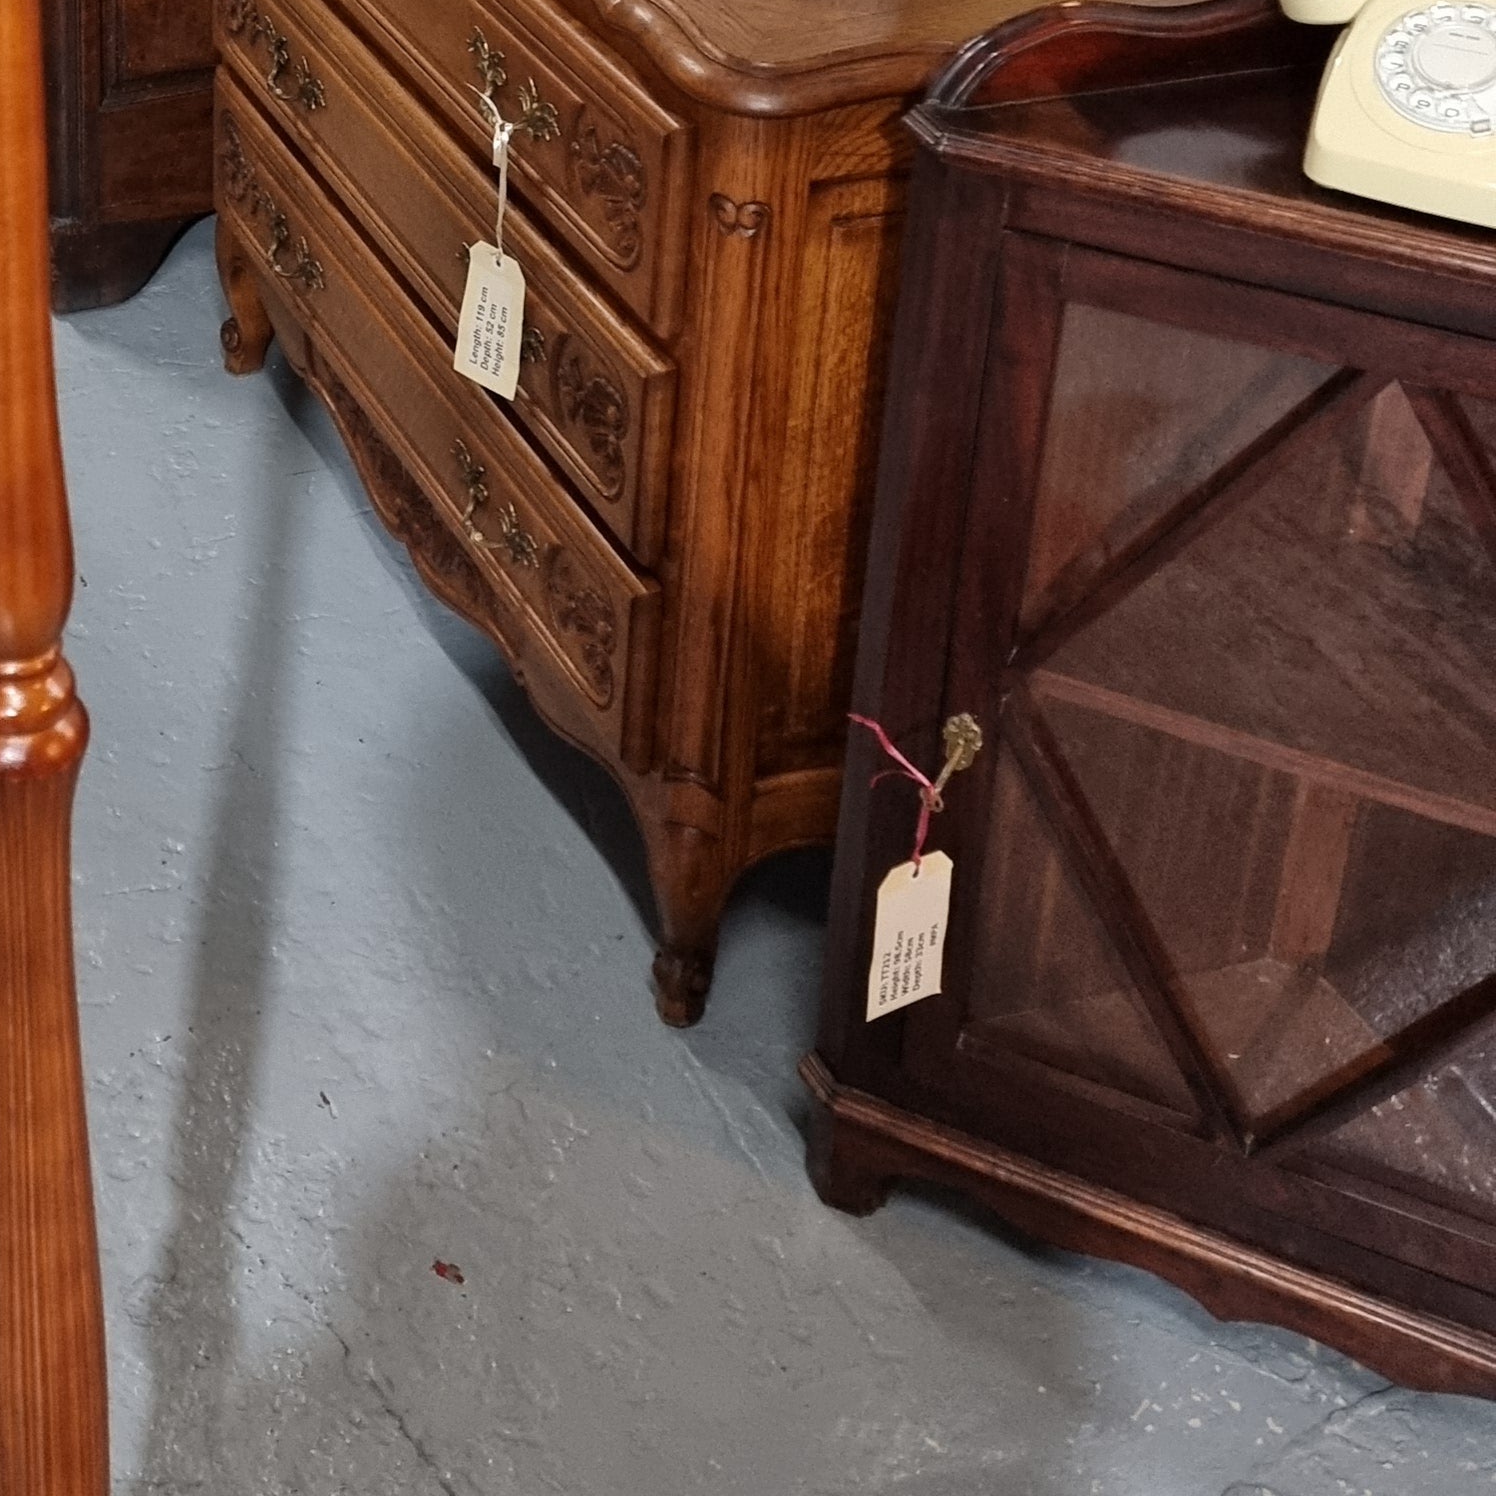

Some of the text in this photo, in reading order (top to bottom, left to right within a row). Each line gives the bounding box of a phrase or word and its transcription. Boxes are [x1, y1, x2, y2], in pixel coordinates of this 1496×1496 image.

[469, 286, 489, 365] Length: 119 cm
[479, 303, 498, 371] Depth: 52 cm
[491, 306, 508, 377] Height: 85 cm
